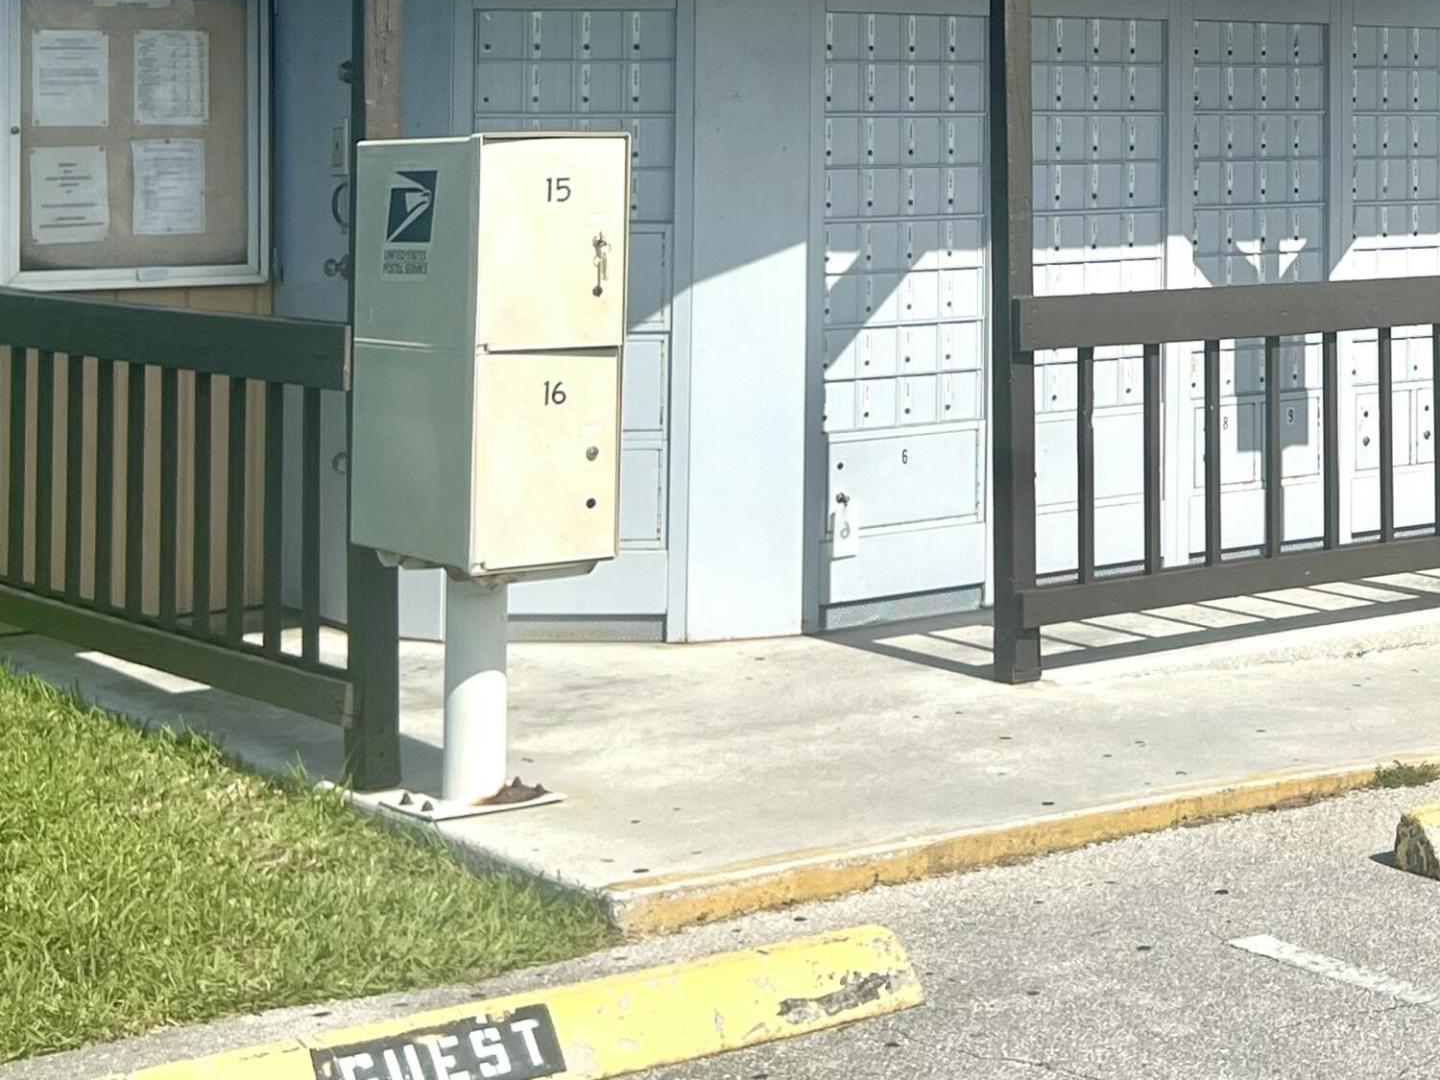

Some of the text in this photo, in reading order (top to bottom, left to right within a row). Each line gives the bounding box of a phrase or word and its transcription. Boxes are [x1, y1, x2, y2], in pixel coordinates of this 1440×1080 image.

[545, 177, 572, 202] 15
[543, 381, 567, 406] 16
[1223, 416, 1229, 430] 8
[1288, 408, 1294, 423] 9
[901, 448, 909, 465] 6
